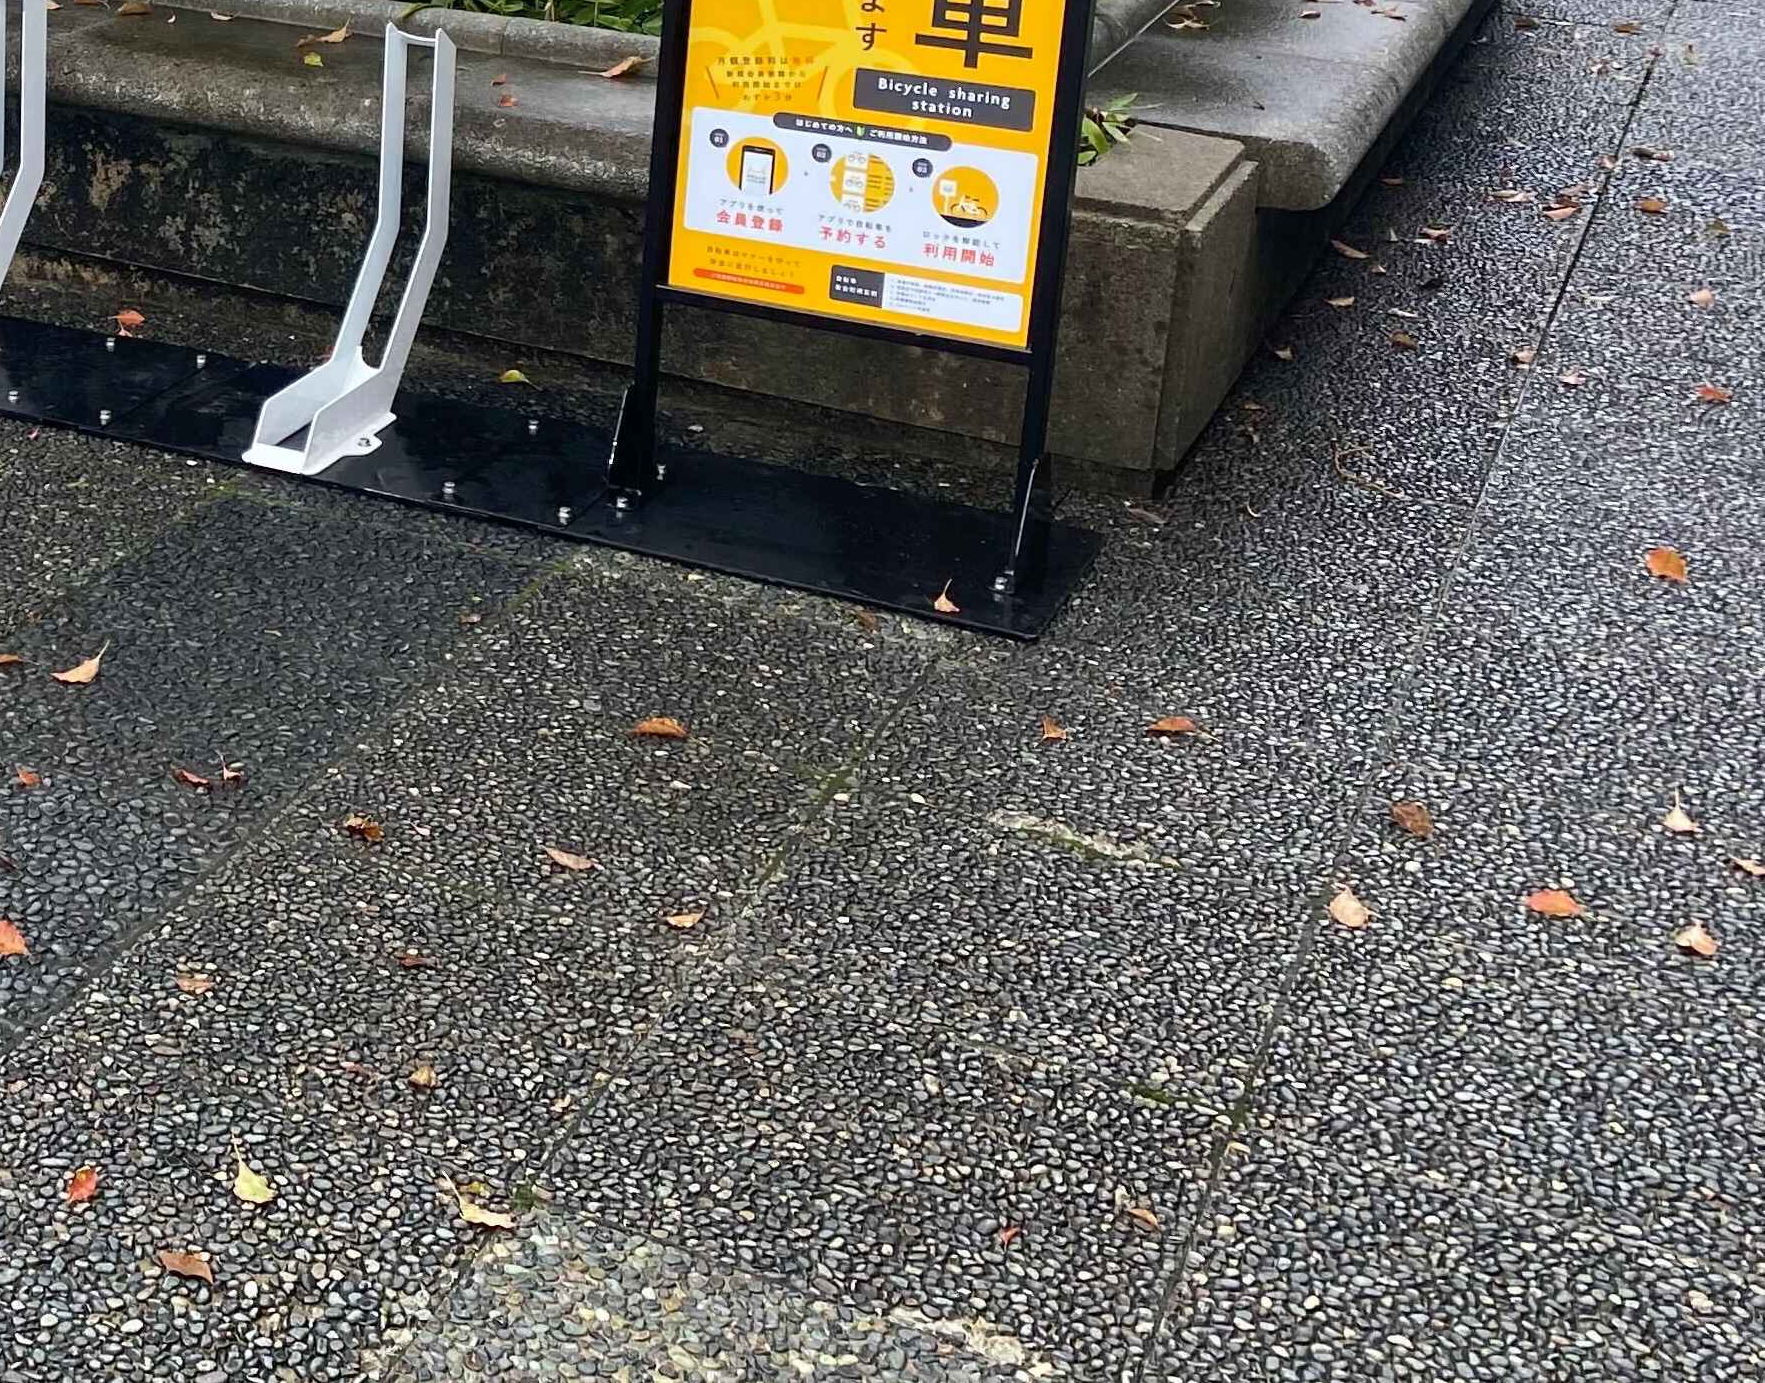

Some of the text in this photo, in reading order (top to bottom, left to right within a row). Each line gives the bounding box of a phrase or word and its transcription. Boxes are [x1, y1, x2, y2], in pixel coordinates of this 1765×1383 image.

[878, 77, 1011, 110] Bicycle sharing
[912, 100, 973, 118] station
[795, 118, 853, 133] はじめての方へ
[716, 209, 783, 232] 会員登録
[818, 226, 886, 249] 予約する
[922, 243, 995, 266] 利用開始
